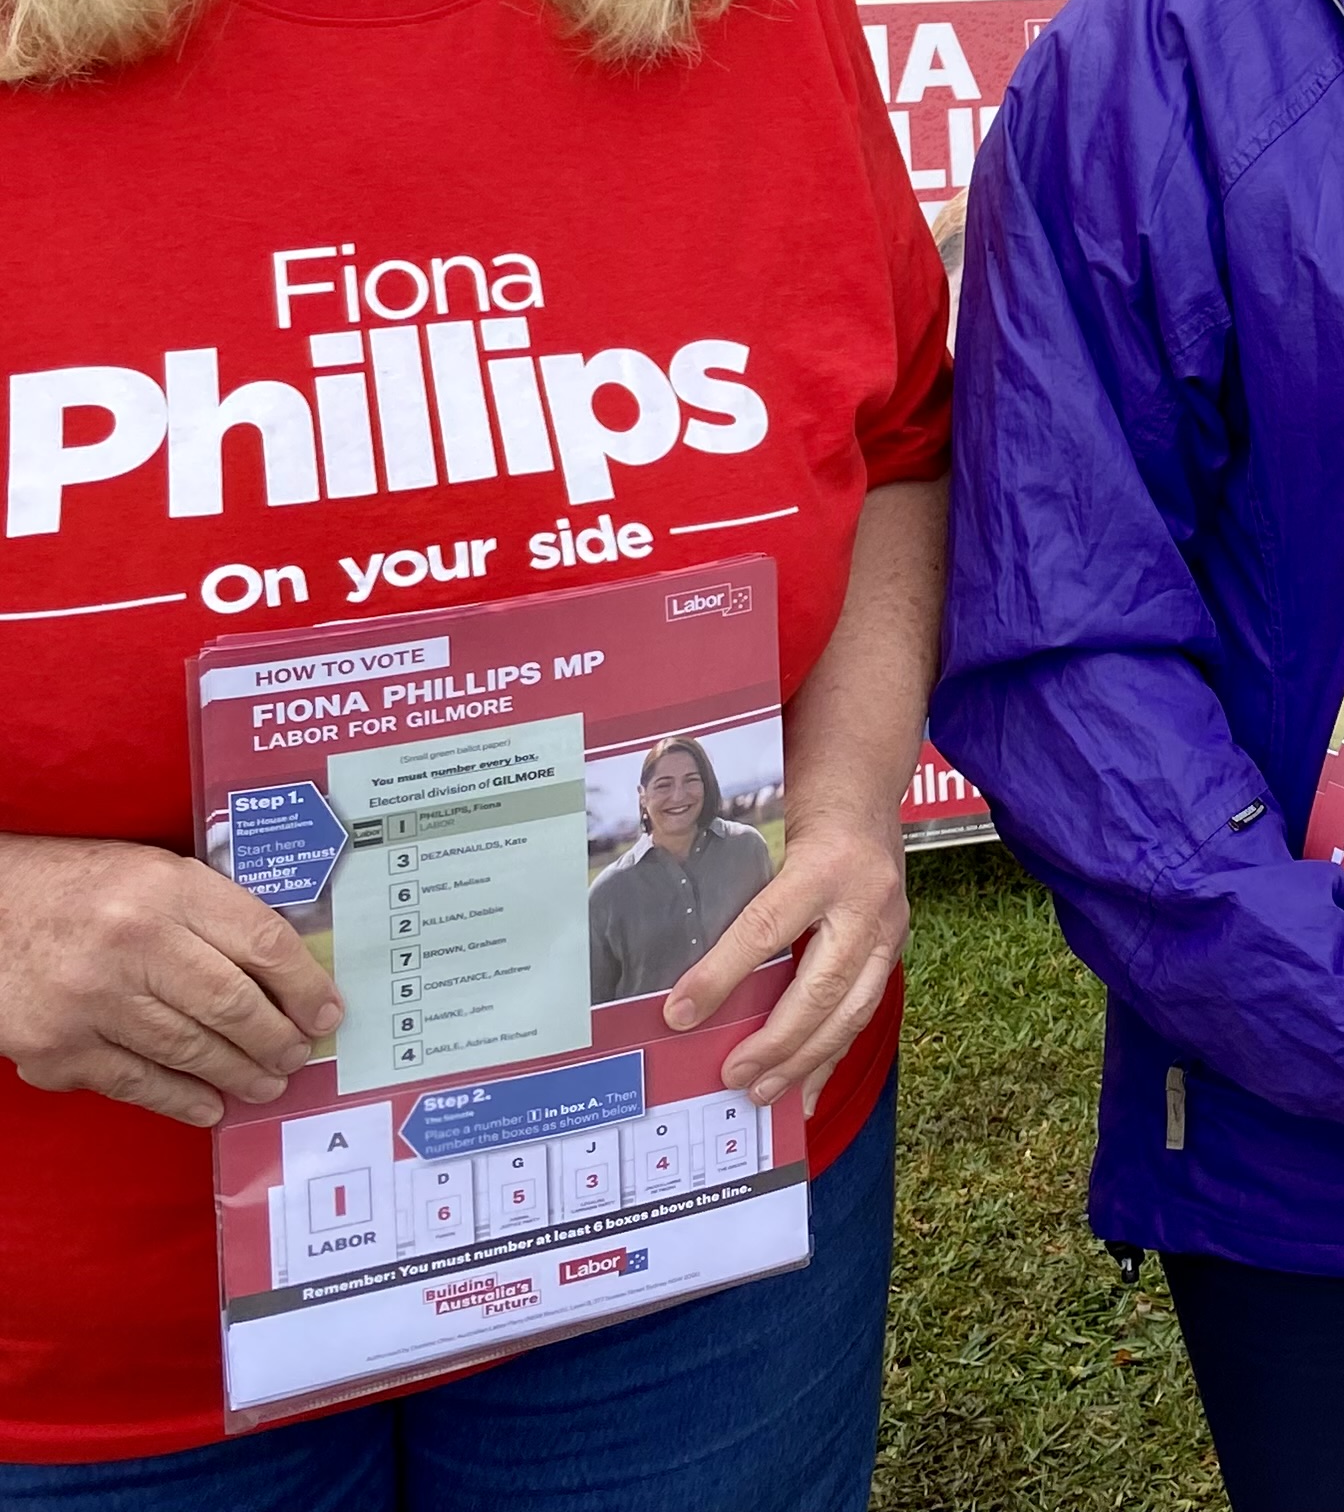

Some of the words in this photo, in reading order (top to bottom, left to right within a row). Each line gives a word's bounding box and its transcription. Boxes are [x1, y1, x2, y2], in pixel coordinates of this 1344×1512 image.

[273, 243, 545, 329] Fiona
[6, 317, 769, 538] Phillips
[200, 563, 309, 615] On
[345, 533, 496, 602] your
[529, 517, 654, 571] side
[672, 591, 724, 615] Labor
[255, 665, 316, 687] HOW
[321, 659, 355, 676] TO
[360, 648, 425, 669] VOTE
[253, 690, 369, 727] FIONA
[383, 662, 542, 709] PHILLIPS
[553, 650, 605, 679] MP
[253, 724, 338, 752] LABOR
[349, 715, 397, 736] FOR
[406, 697, 513, 726] GILMORE
[371, 777, 393, 787] You
[397, 771, 427, 783] must
[431, 763, 475, 777] number
[480, 755, 511, 769] every
[515, 752, 539, 763] box.
[236, 795, 284, 811] Step
[288, 791, 304, 804] 1.
[369, 790, 425, 808] Electoral
[428, 782, 476, 798] division
[479, 779, 490, 790] of
[493, 768, 555, 787] GILMORE
[237, 844, 271, 856] Start
[276, 840, 305, 851] here
[238, 857, 263, 869] and
[267, 853, 293, 867] you
[298, 847, 335, 860] must
[239, 867, 297, 883] number
[302, 1271, 396, 1300] Remember:
[399, 1263, 428, 1277] You
[432, 1252, 471, 1270] must
[474, 1238, 533, 1260] number
[536, 1234, 551, 1245] at
[554, 1224, 590, 1241] least
[594, 1221, 603, 1232] 6
[606, 1210, 648, 1229] boxes
[651, 1199, 694, 1218] above
[696, 1193, 719, 1206] the
[722, 1185, 752, 1199] line.
[308, 1231, 376, 1256] LABOR
[565, 1255, 621, 1280] Labor
[426, 1278, 495, 1301] Building
[438, 1281, 529, 1313] Australia's
[486, 1295, 538, 1315] Future
